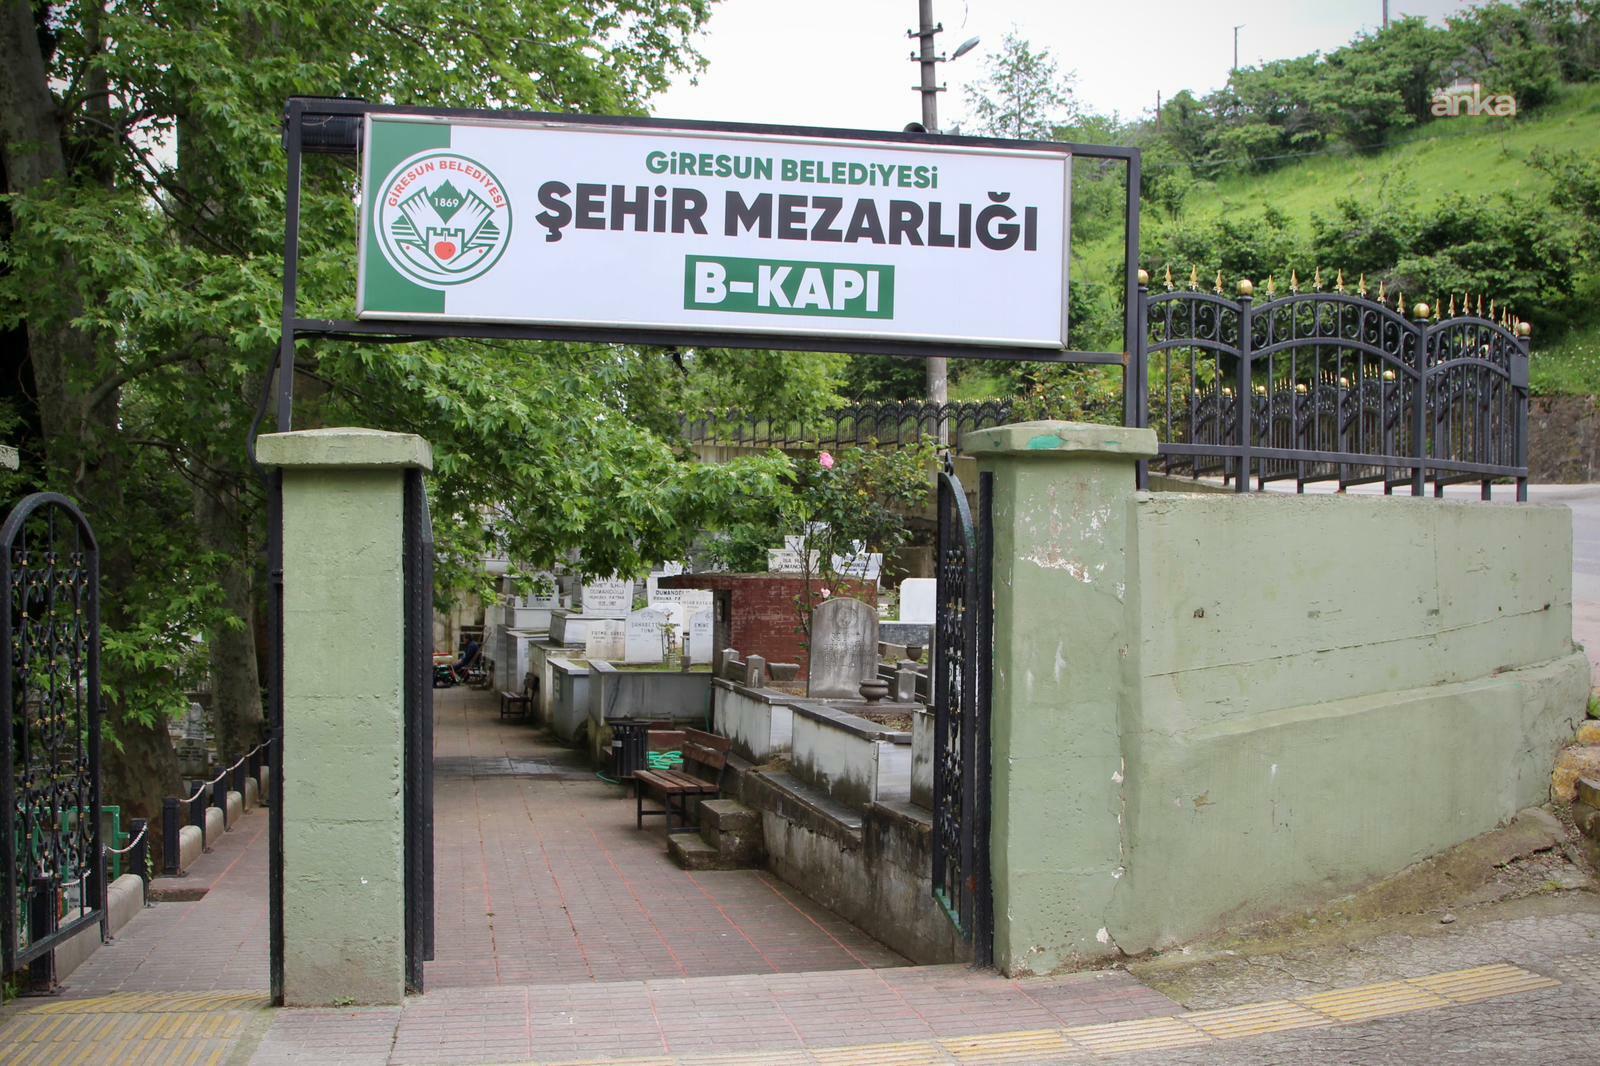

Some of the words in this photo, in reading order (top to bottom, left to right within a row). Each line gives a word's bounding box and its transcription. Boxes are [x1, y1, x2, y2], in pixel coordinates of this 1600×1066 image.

[434, 197, 460, 208] 1869
[725, 190, 1038, 252] MEZARLIĞI
[694, 262, 879, 312] B-KAPI
